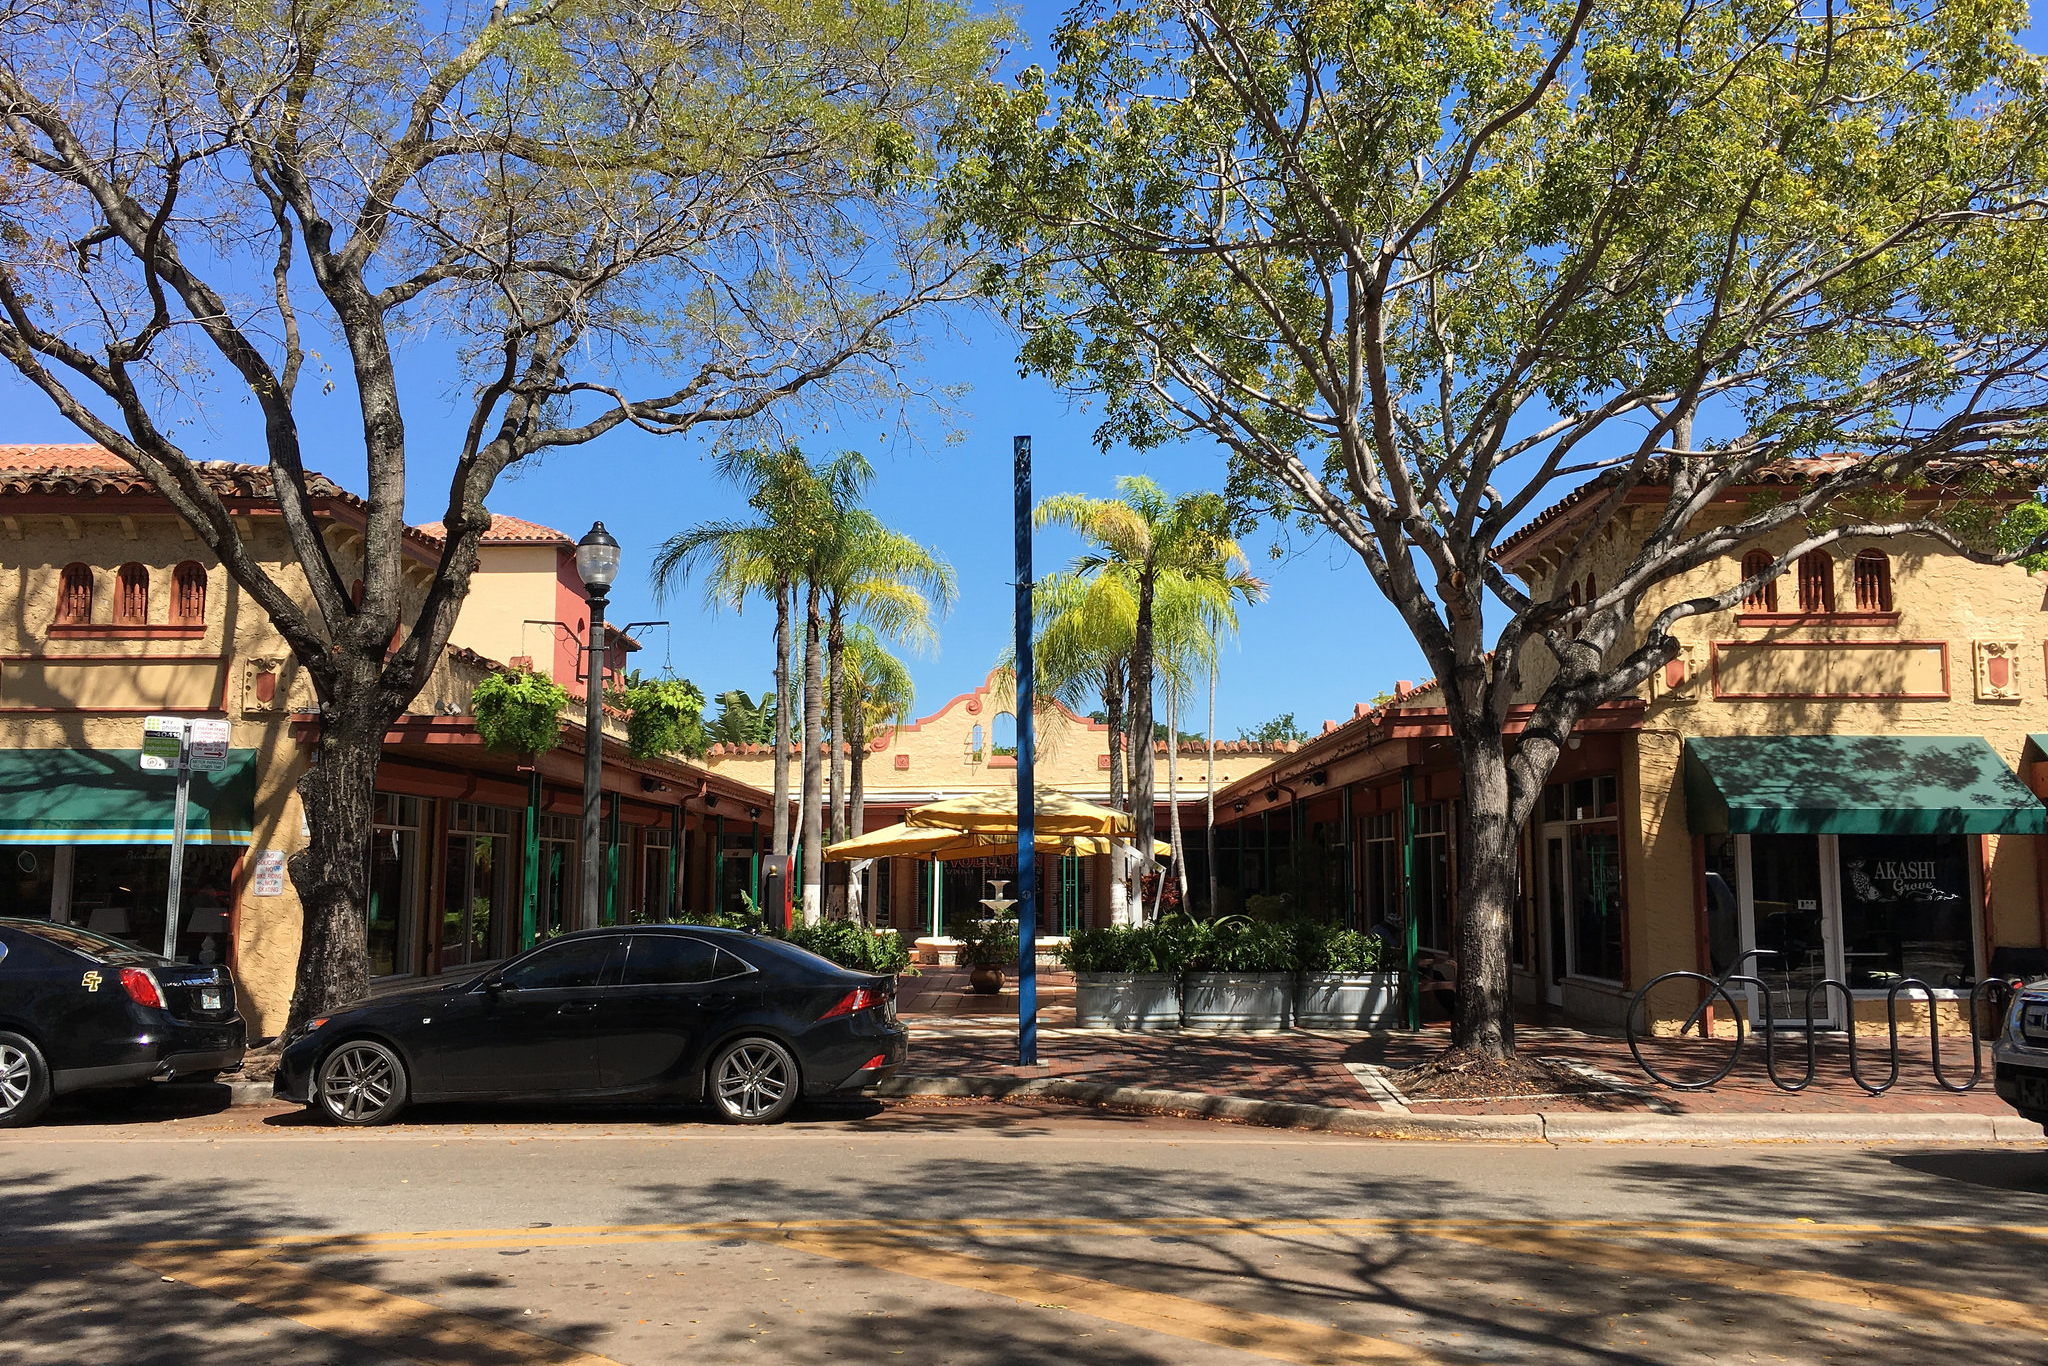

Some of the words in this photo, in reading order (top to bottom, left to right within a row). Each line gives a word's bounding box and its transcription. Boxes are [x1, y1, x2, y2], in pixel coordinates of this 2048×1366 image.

[923, 854, 1042, 868] VOLUTIN
[1874, 861, 1936, 880] AKASHI
[1892, 878, 1934, 895] Grove
